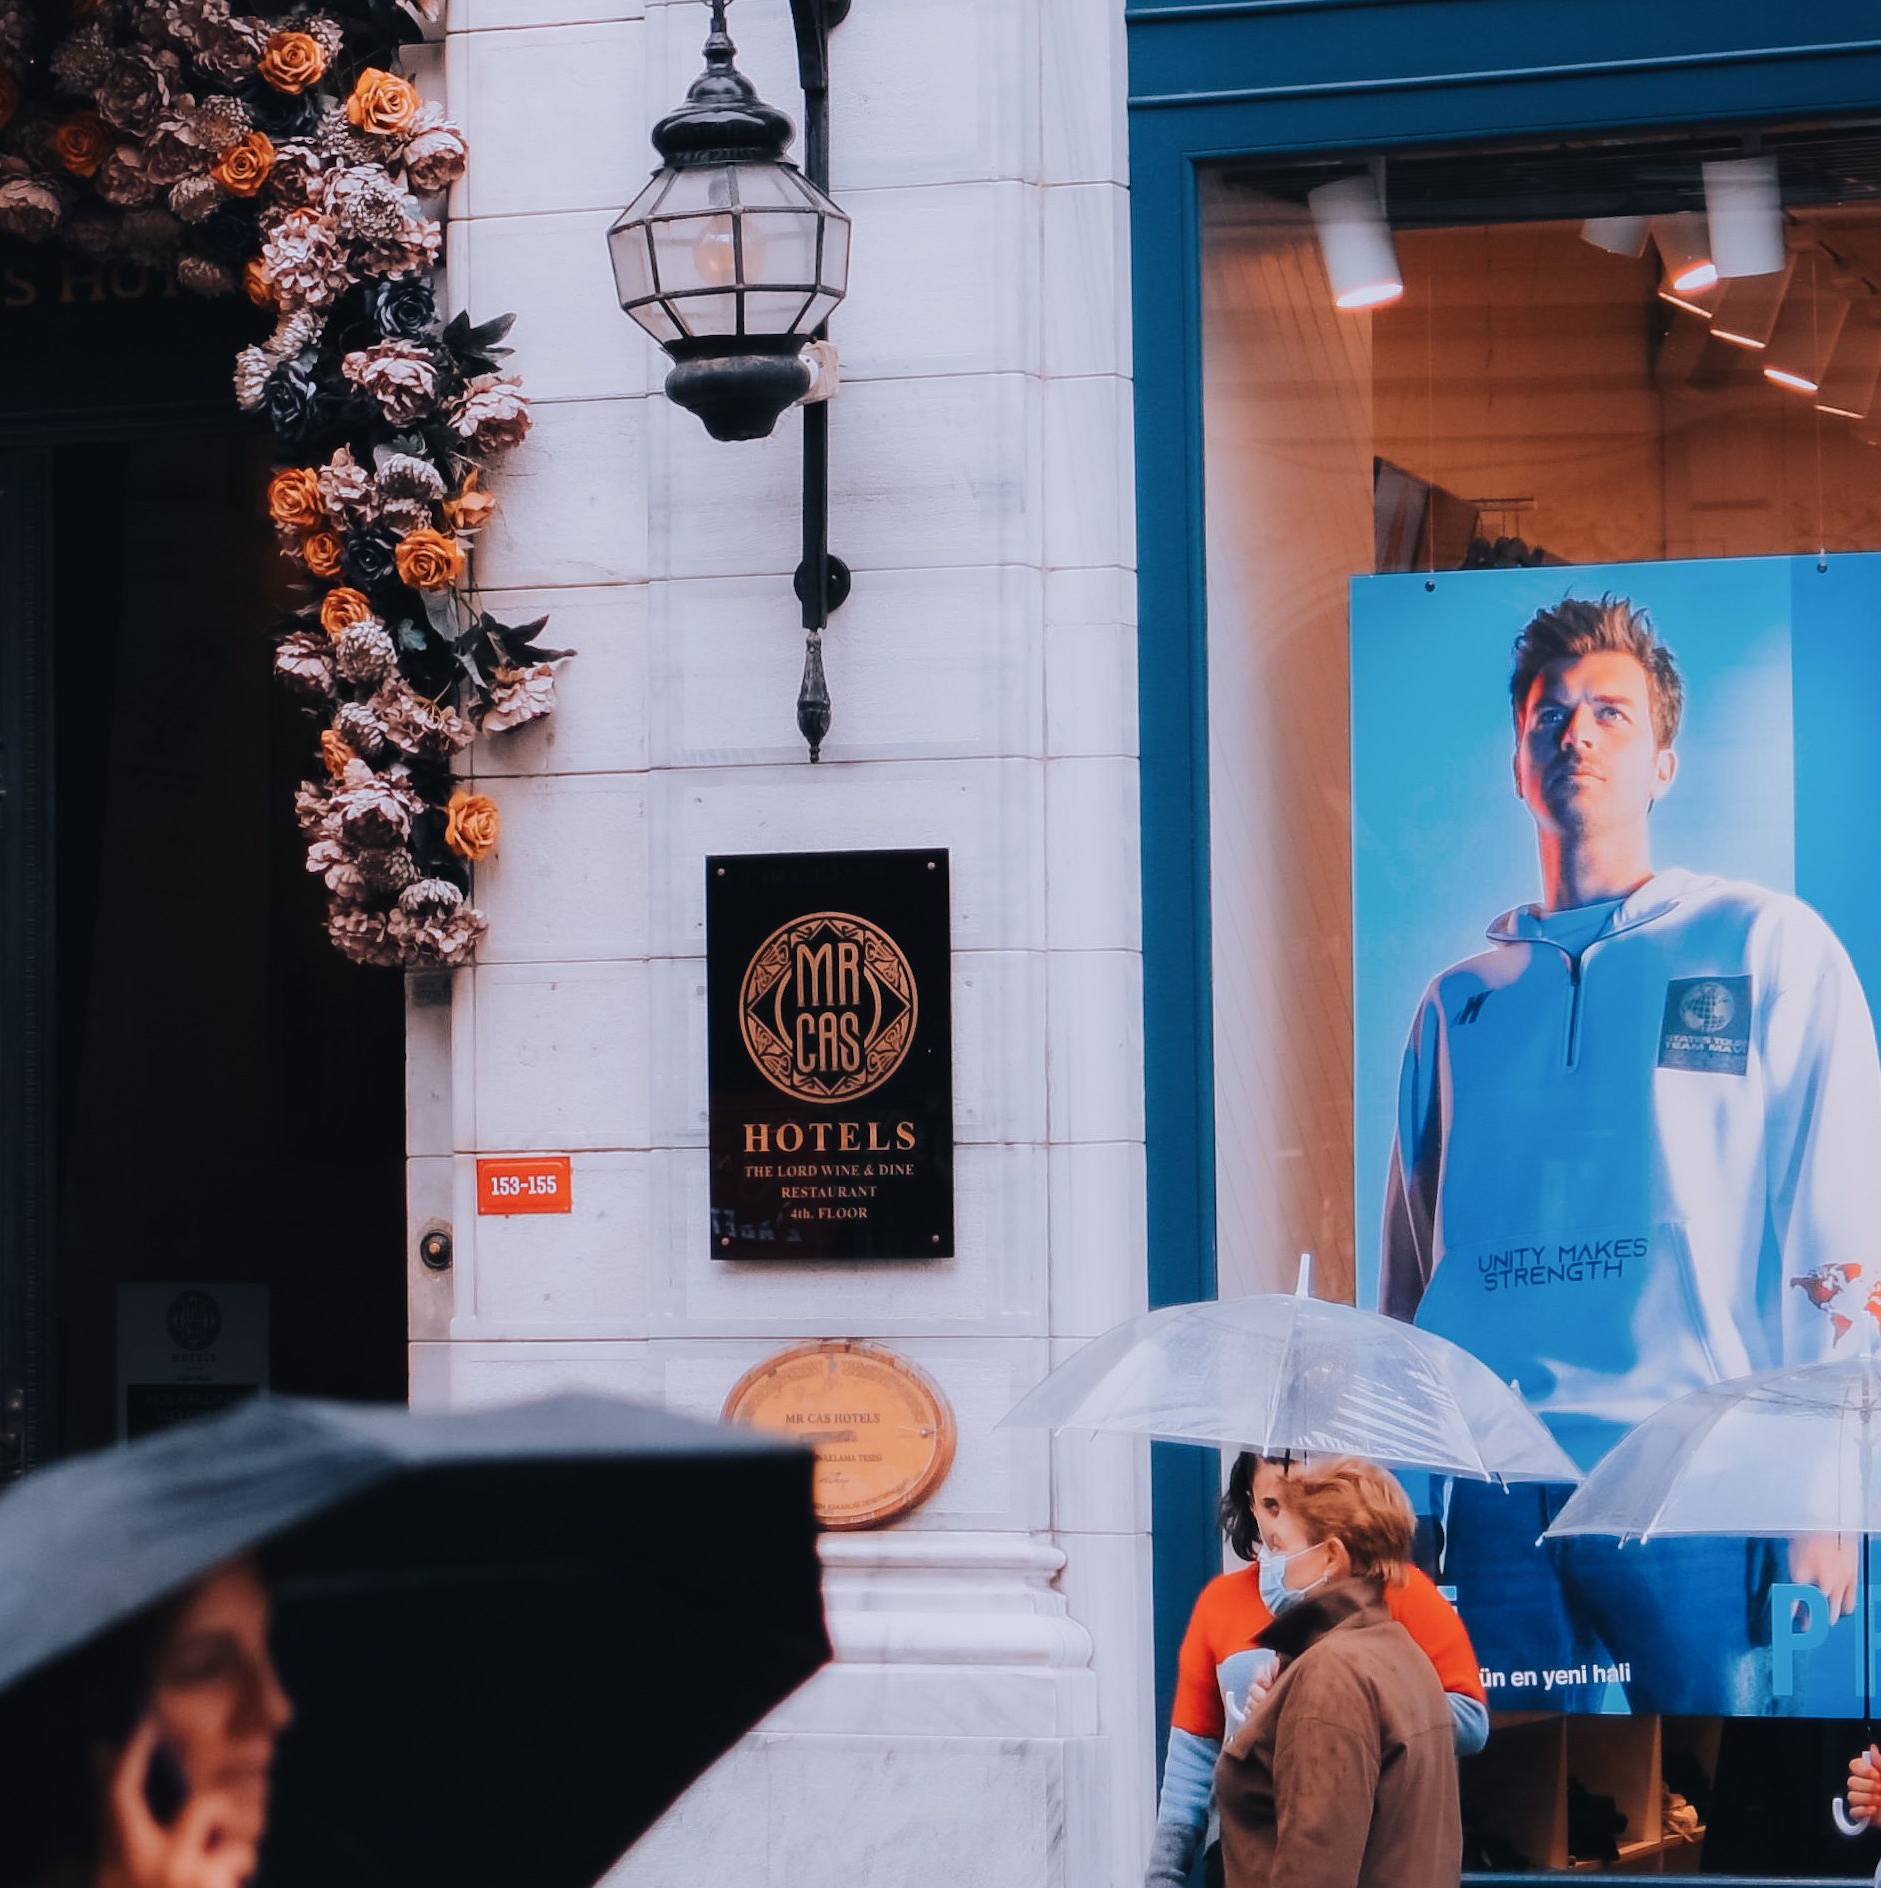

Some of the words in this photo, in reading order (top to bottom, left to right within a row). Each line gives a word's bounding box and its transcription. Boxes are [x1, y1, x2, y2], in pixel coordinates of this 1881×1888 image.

[795, 942, 861, 1008] MR
[795, 1011, 863, 1074] CAS
[743, 1121, 917, 1153] HOTELS
[744, 1165, 774, 1178] THE
[777, 1164, 818, 1178] LORD
[820, 1164, 860, 1177] WINE
[863, 1164, 875, 1177] &
[879, 1163, 915, 1176] DINE
[490, 1175, 558, 1196] 153-155
[781, 1185, 878, 1199] RESTAURANT
[818, 1207, 868, 1220] FLOOR
[1478, 1246, 1546, 1273] UNITY
[1558, 1237, 1648, 1262] MAKES
[1484, 1259, 1623, 1292] STRENGTH
[785, 1413, 804, 1425] MR
[807, 1413, 831, 1424] CAS
[834, 1412, 881, 1424] HOTELS
[1511, 1669, 1538, 1687] en
[1542, 1664, 1588, 1691] yeni
[1593, 1662, 1632, 1684] hali
